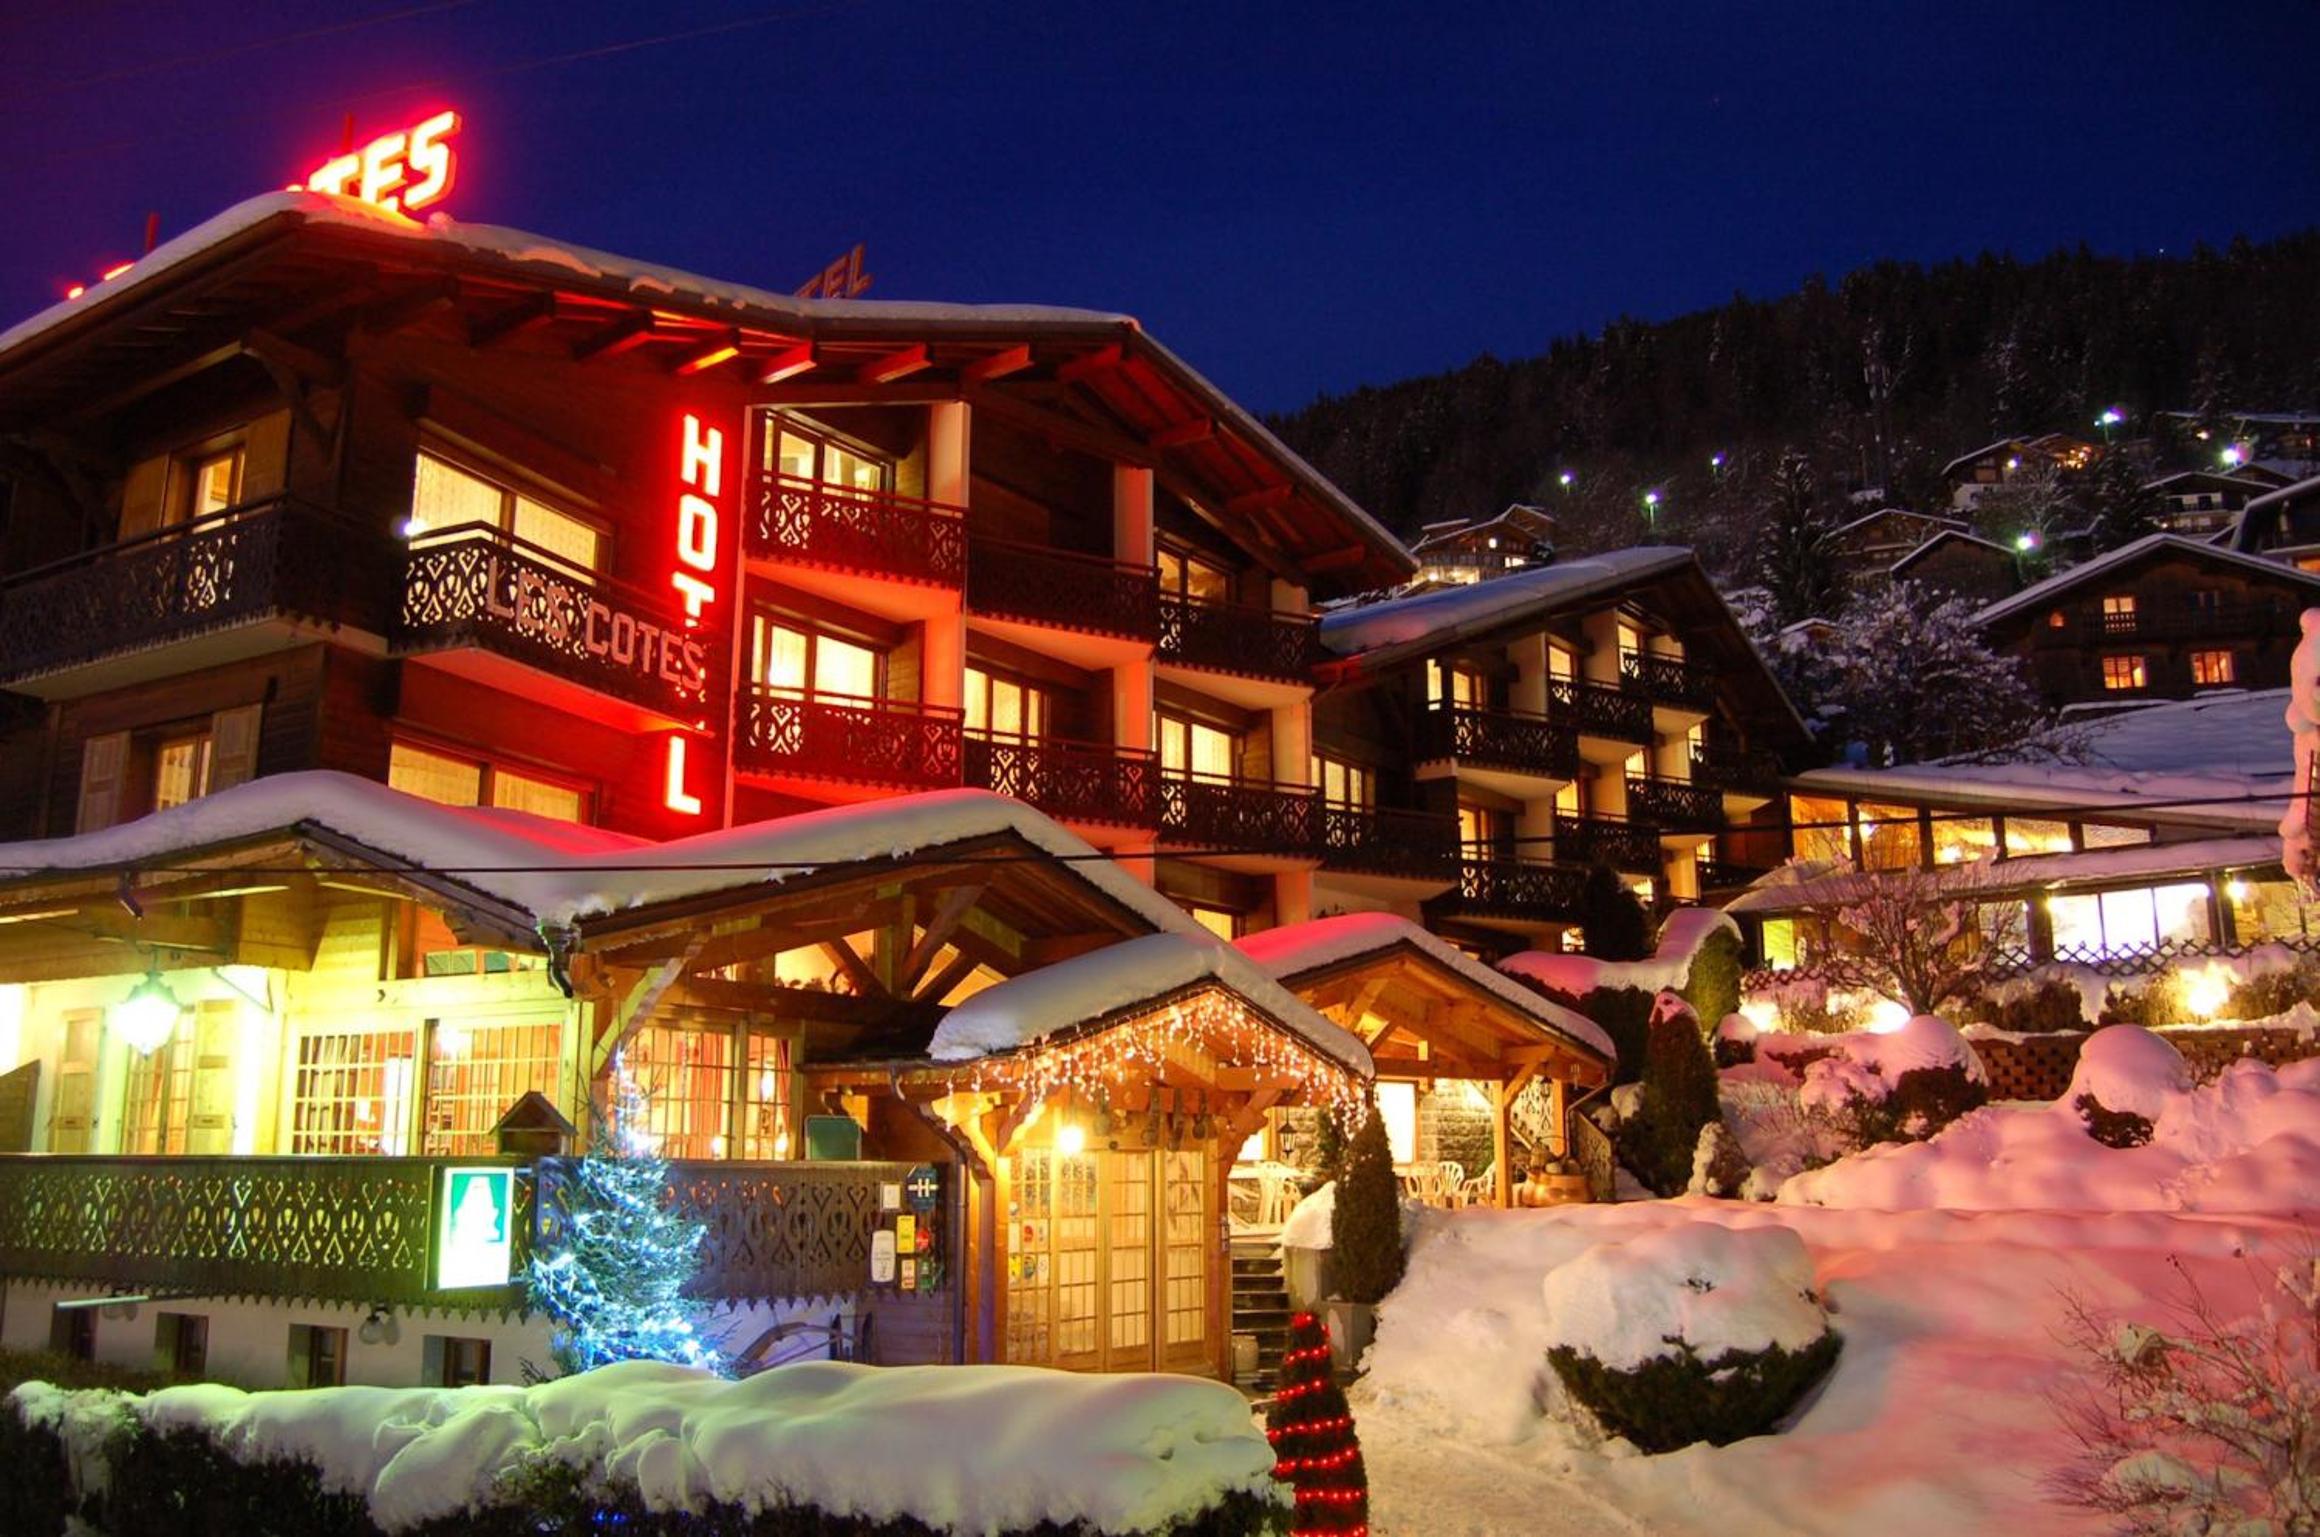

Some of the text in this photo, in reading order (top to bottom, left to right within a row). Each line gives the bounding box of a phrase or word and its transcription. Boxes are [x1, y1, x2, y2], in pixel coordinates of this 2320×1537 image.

[486, 556, 704, 691] LES COTES
[664, 413, 722, 815] HOTL
